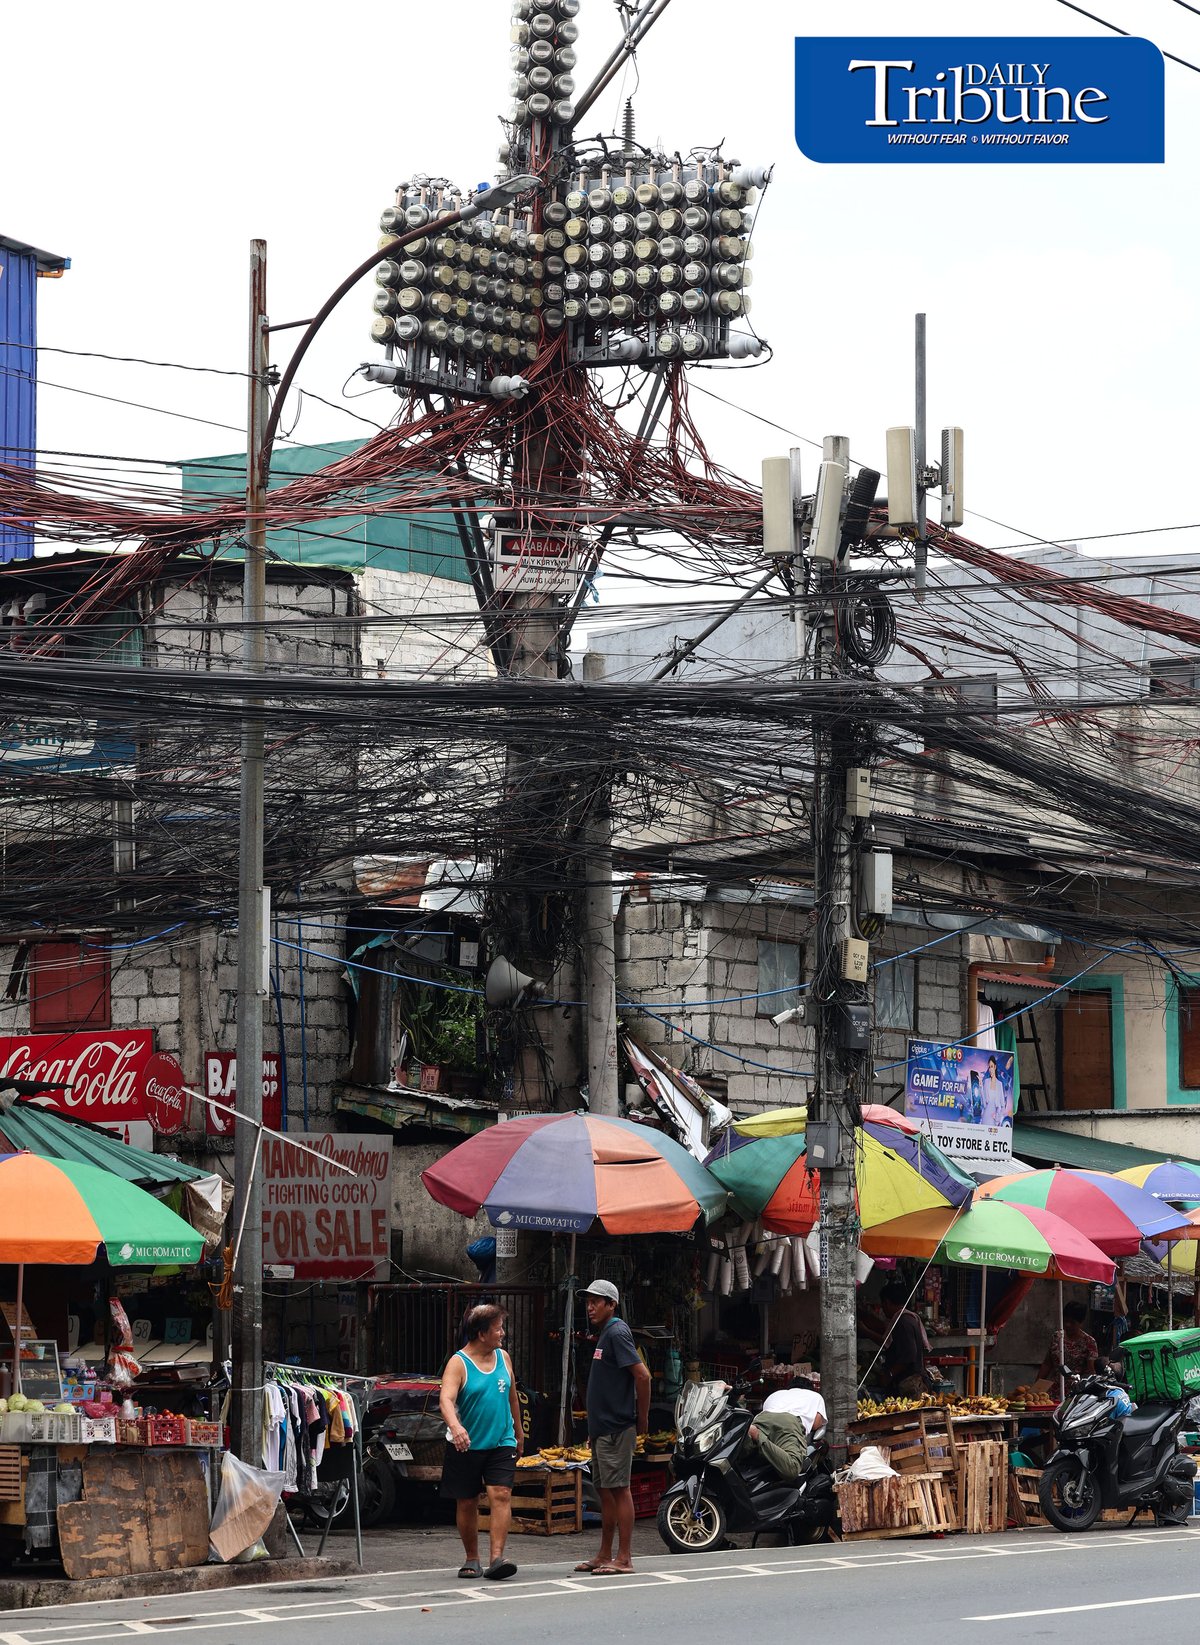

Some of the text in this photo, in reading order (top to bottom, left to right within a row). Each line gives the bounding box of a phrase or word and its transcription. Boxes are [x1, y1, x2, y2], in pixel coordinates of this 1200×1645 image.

[0, 1041, 145, 1107] Coca-Cola
[913, 1073, 939, 1089] GAME
[941, 1081, 954, 1092] FOR
[146, 1077, 182, 1111] Coca-Cola
[929, 1095, 938, 1105] FOR
[938, 1094, 955, 1108] LIFE
[937, 1135, 954, 1148] TOY
[955, 1137, 983, 1151] STORE
[984, 1140, 991, 1152] &
[992, 1141, 1010, 1154] ETC.
[515, 1213, 581, 1229] MICROMATIC
[261, 1208, 389, 1259] FOR SALE
[135, 1246, 191, 1258] MICROMATIC
[975, 1250, 1040, 1267] MICROMATIC
[134, 1321, 149, 1339] 58
